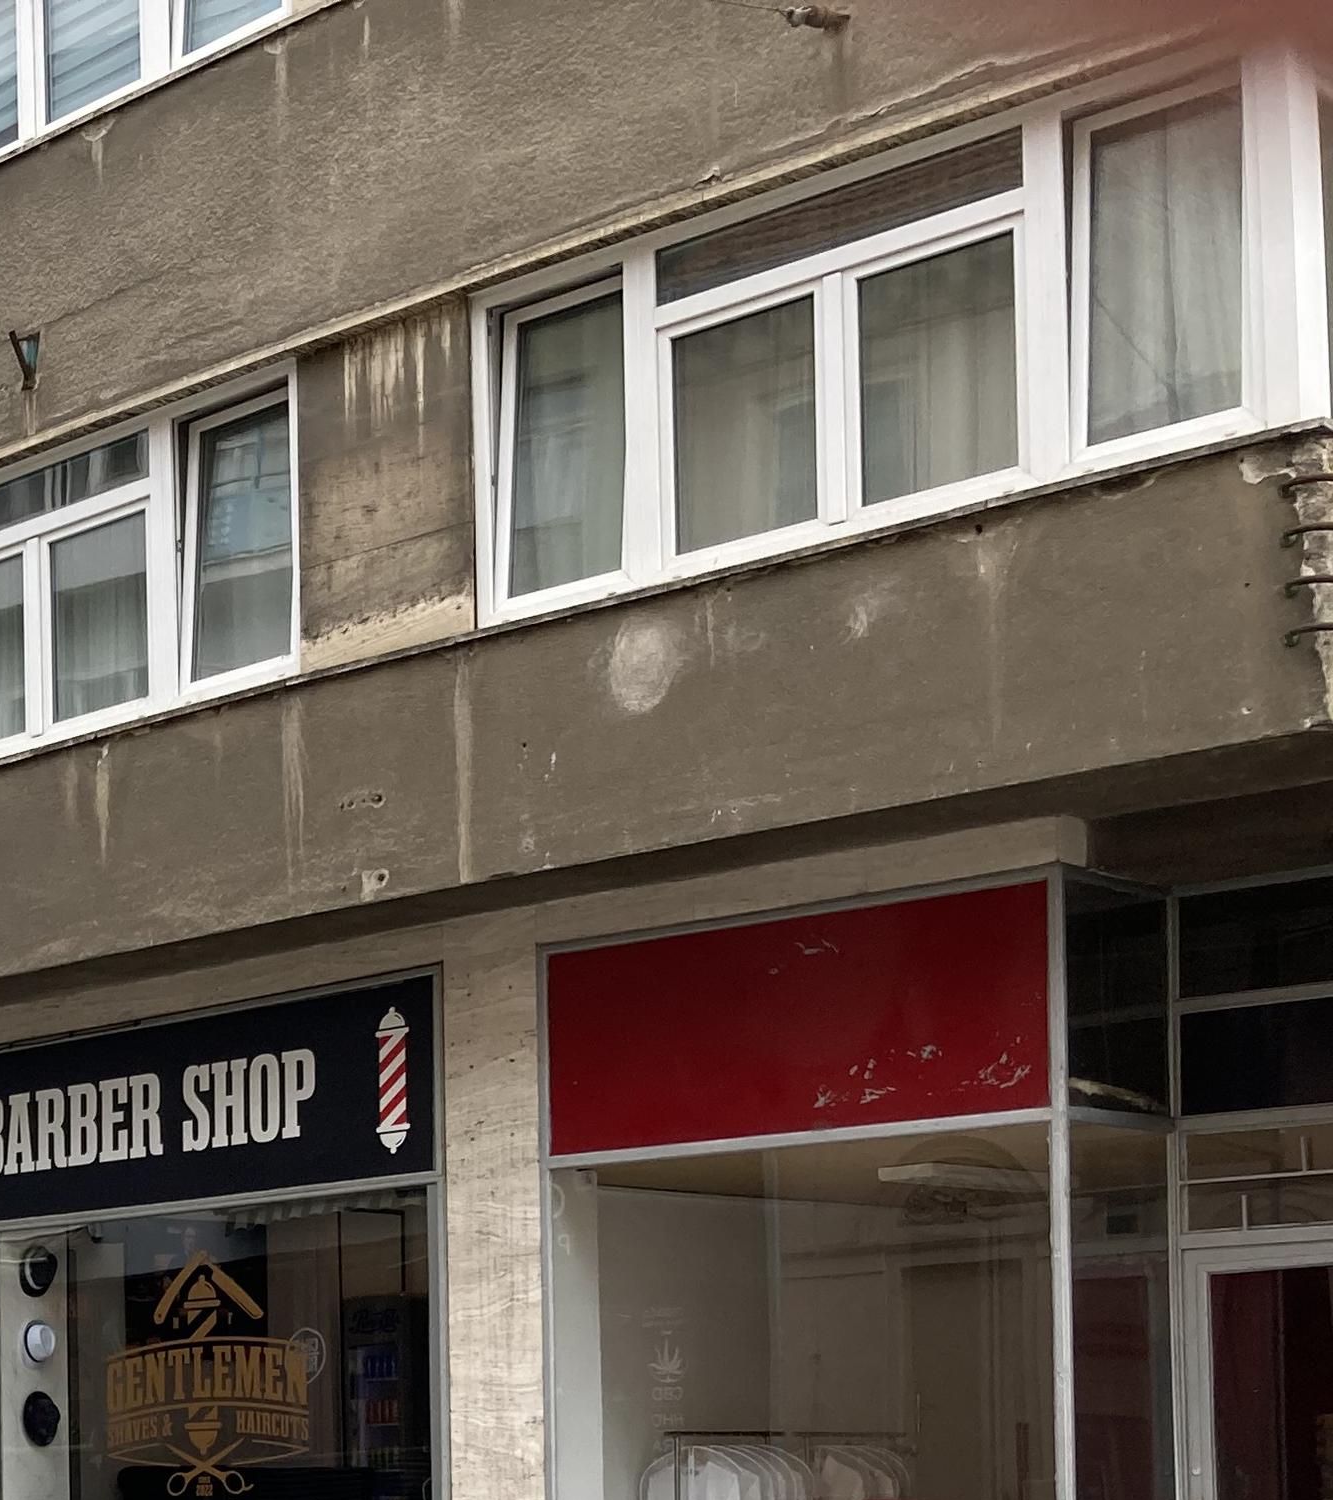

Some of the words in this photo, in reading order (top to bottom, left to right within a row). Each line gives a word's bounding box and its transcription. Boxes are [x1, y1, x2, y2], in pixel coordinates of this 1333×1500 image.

[182, 1048, 316, 1152] SHOP
[107, 1345, 309, 1415] GENTLEMEN
[108, 1416, 158, 1446] SHAVES
[161, 1413, 174, 1437] &
[235, 1409, 310, 1441] HAIRCUTS
